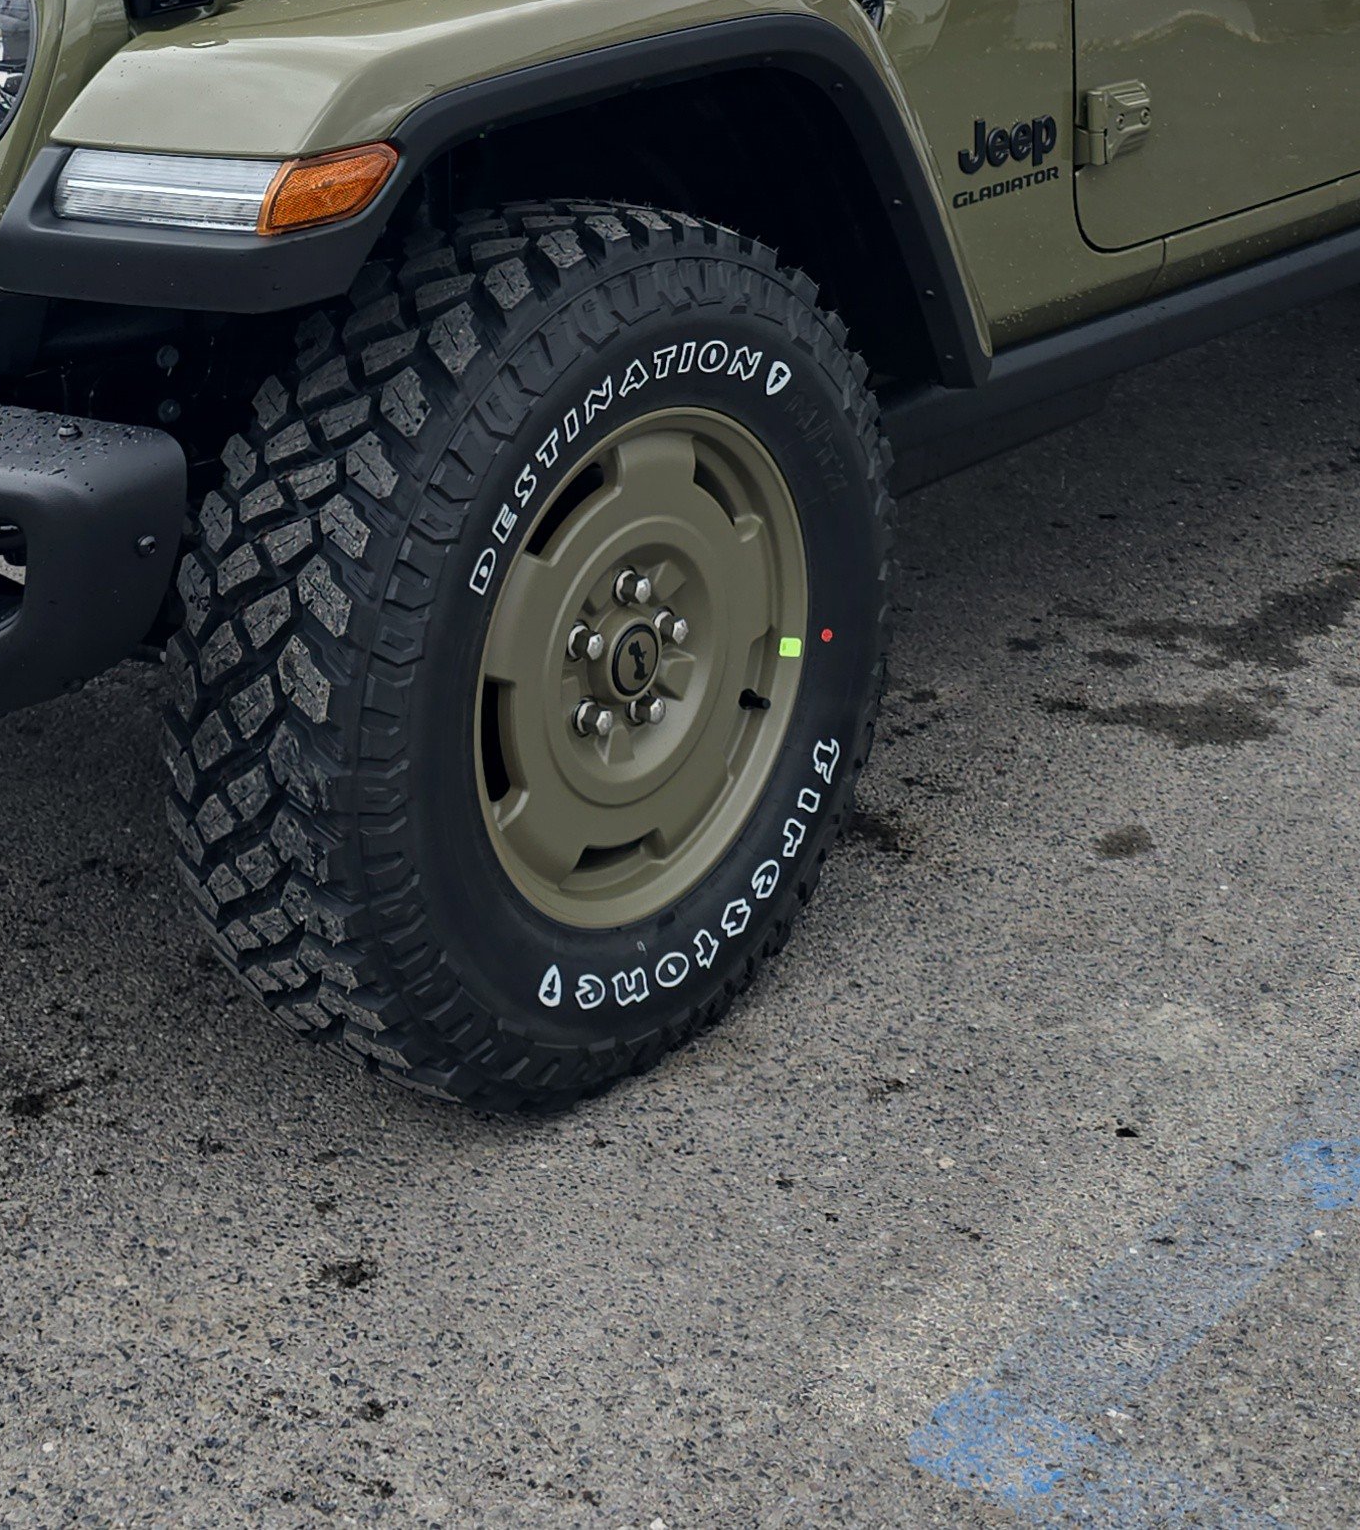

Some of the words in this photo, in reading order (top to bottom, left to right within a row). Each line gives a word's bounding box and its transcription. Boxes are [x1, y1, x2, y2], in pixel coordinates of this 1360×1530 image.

[952, 166, 1060, 209] GLADIATOR
[957, 113, 1058, 176] Jeep
[469, 339, 764, 596] DESTINATION
[575, 736, 841, 1011] Firestone
